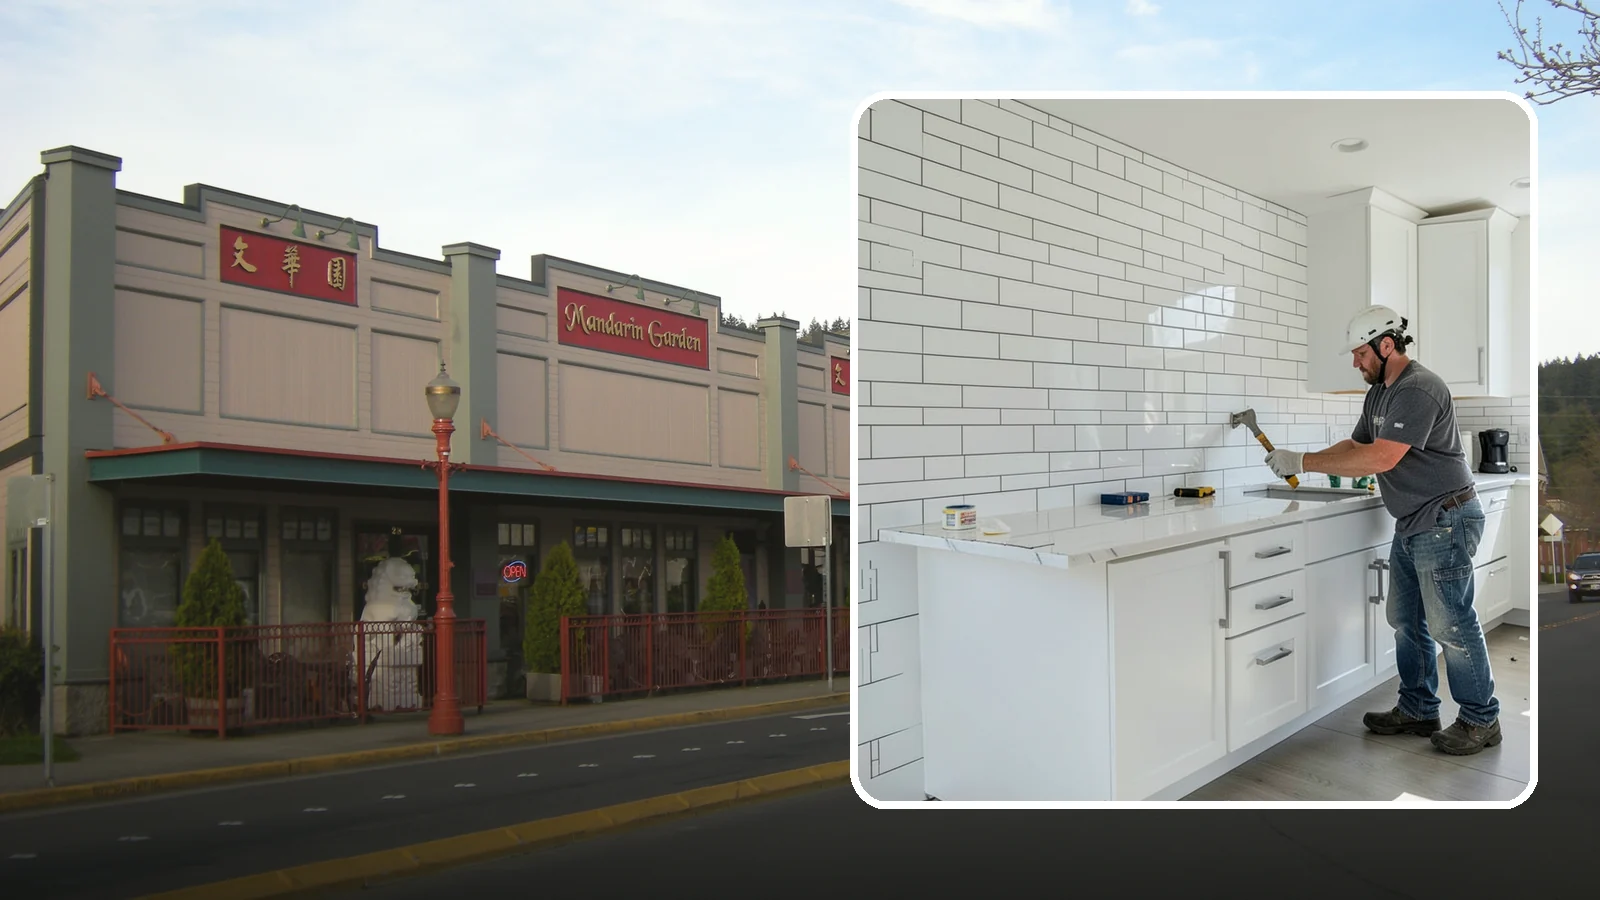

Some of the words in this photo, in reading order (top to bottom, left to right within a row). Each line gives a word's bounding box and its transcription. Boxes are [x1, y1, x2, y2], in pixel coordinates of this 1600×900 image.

[231, 235, 347, 291] 文華園
[564, 302, 644, 341] Mandarin
[647, 320, 702, 352] Garden
[503, 565, 527, 578] OPEN
